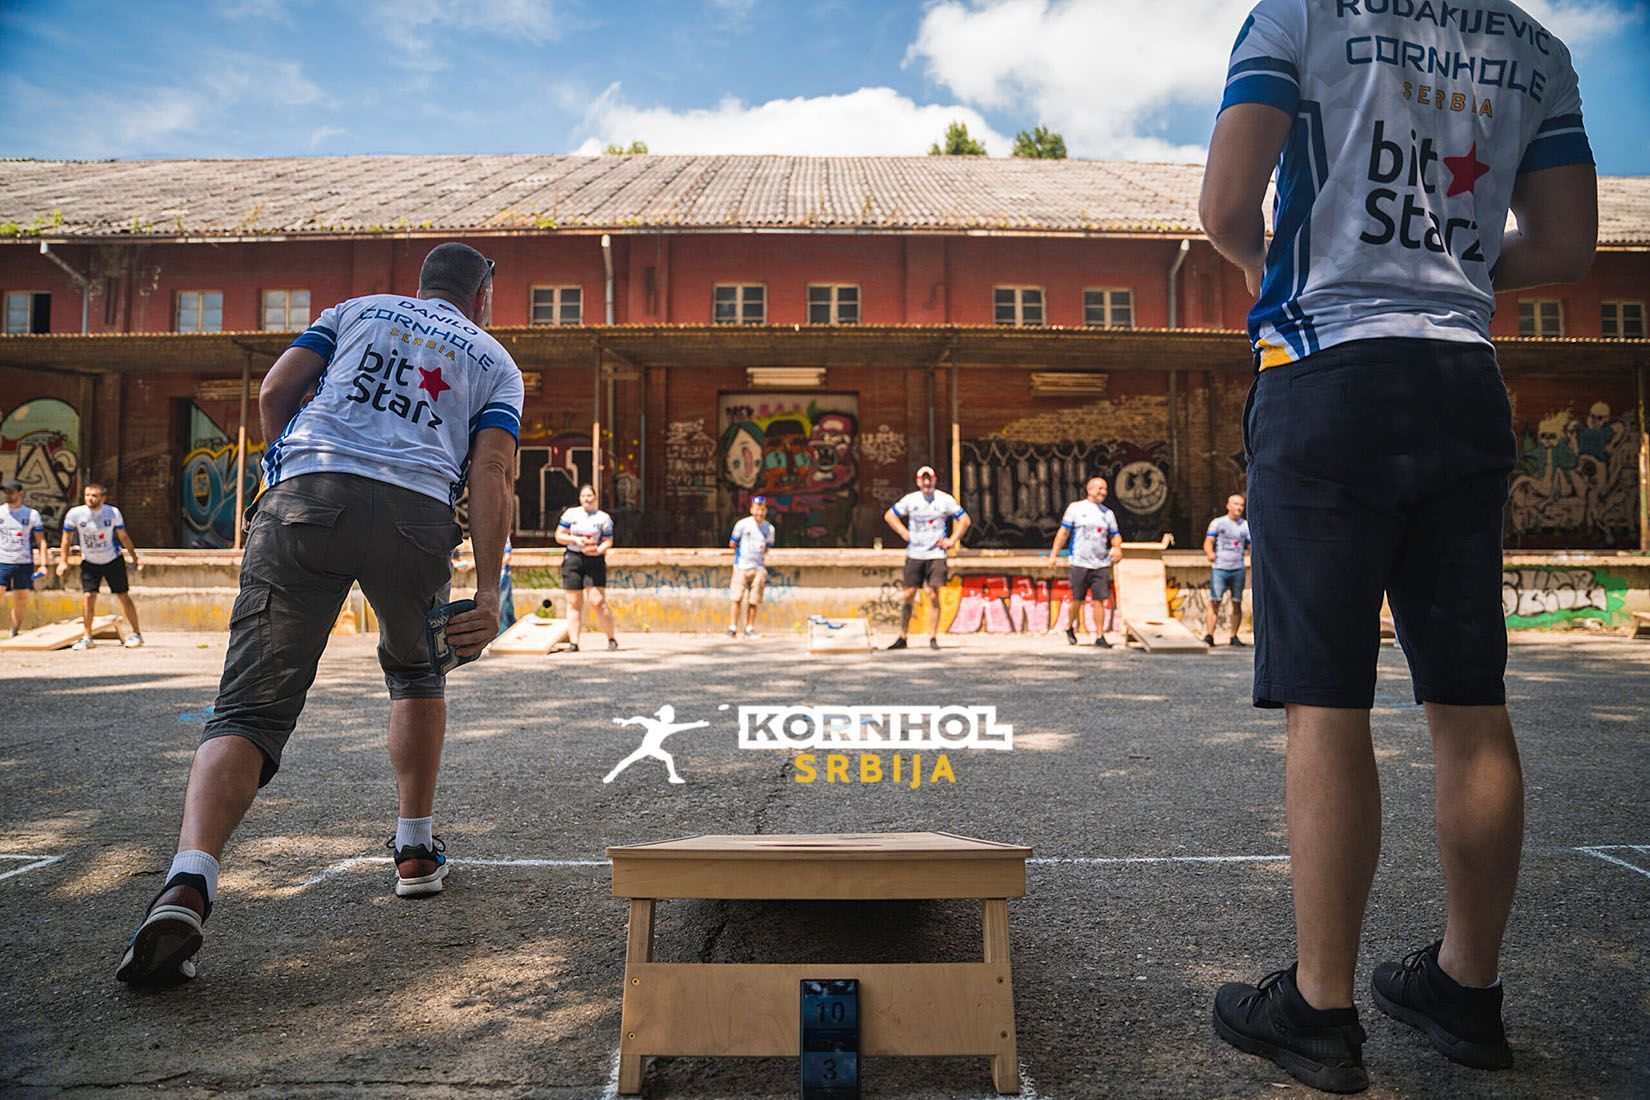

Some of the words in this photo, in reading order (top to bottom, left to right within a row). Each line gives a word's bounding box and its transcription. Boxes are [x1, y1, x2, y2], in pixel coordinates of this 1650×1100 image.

[1346, 35, 1547, 104] CORNHOLE
[1402, 81, 1494, 118] SERBIA
[1368, 120, 1438, 193] bit
[1359, 188, 1485, 262] Starz
[359, 308, 495, 372] CORNHOLE
[398, 300, 478, 336] DANILO
[357, 342, 414, 386] bit
[390, 327, 456, 361] SERBIA
[346, 373, 444, 432] Starz
[816, 1001, 845, 1023] 10
[823, 1058, 838, 1081] 3
